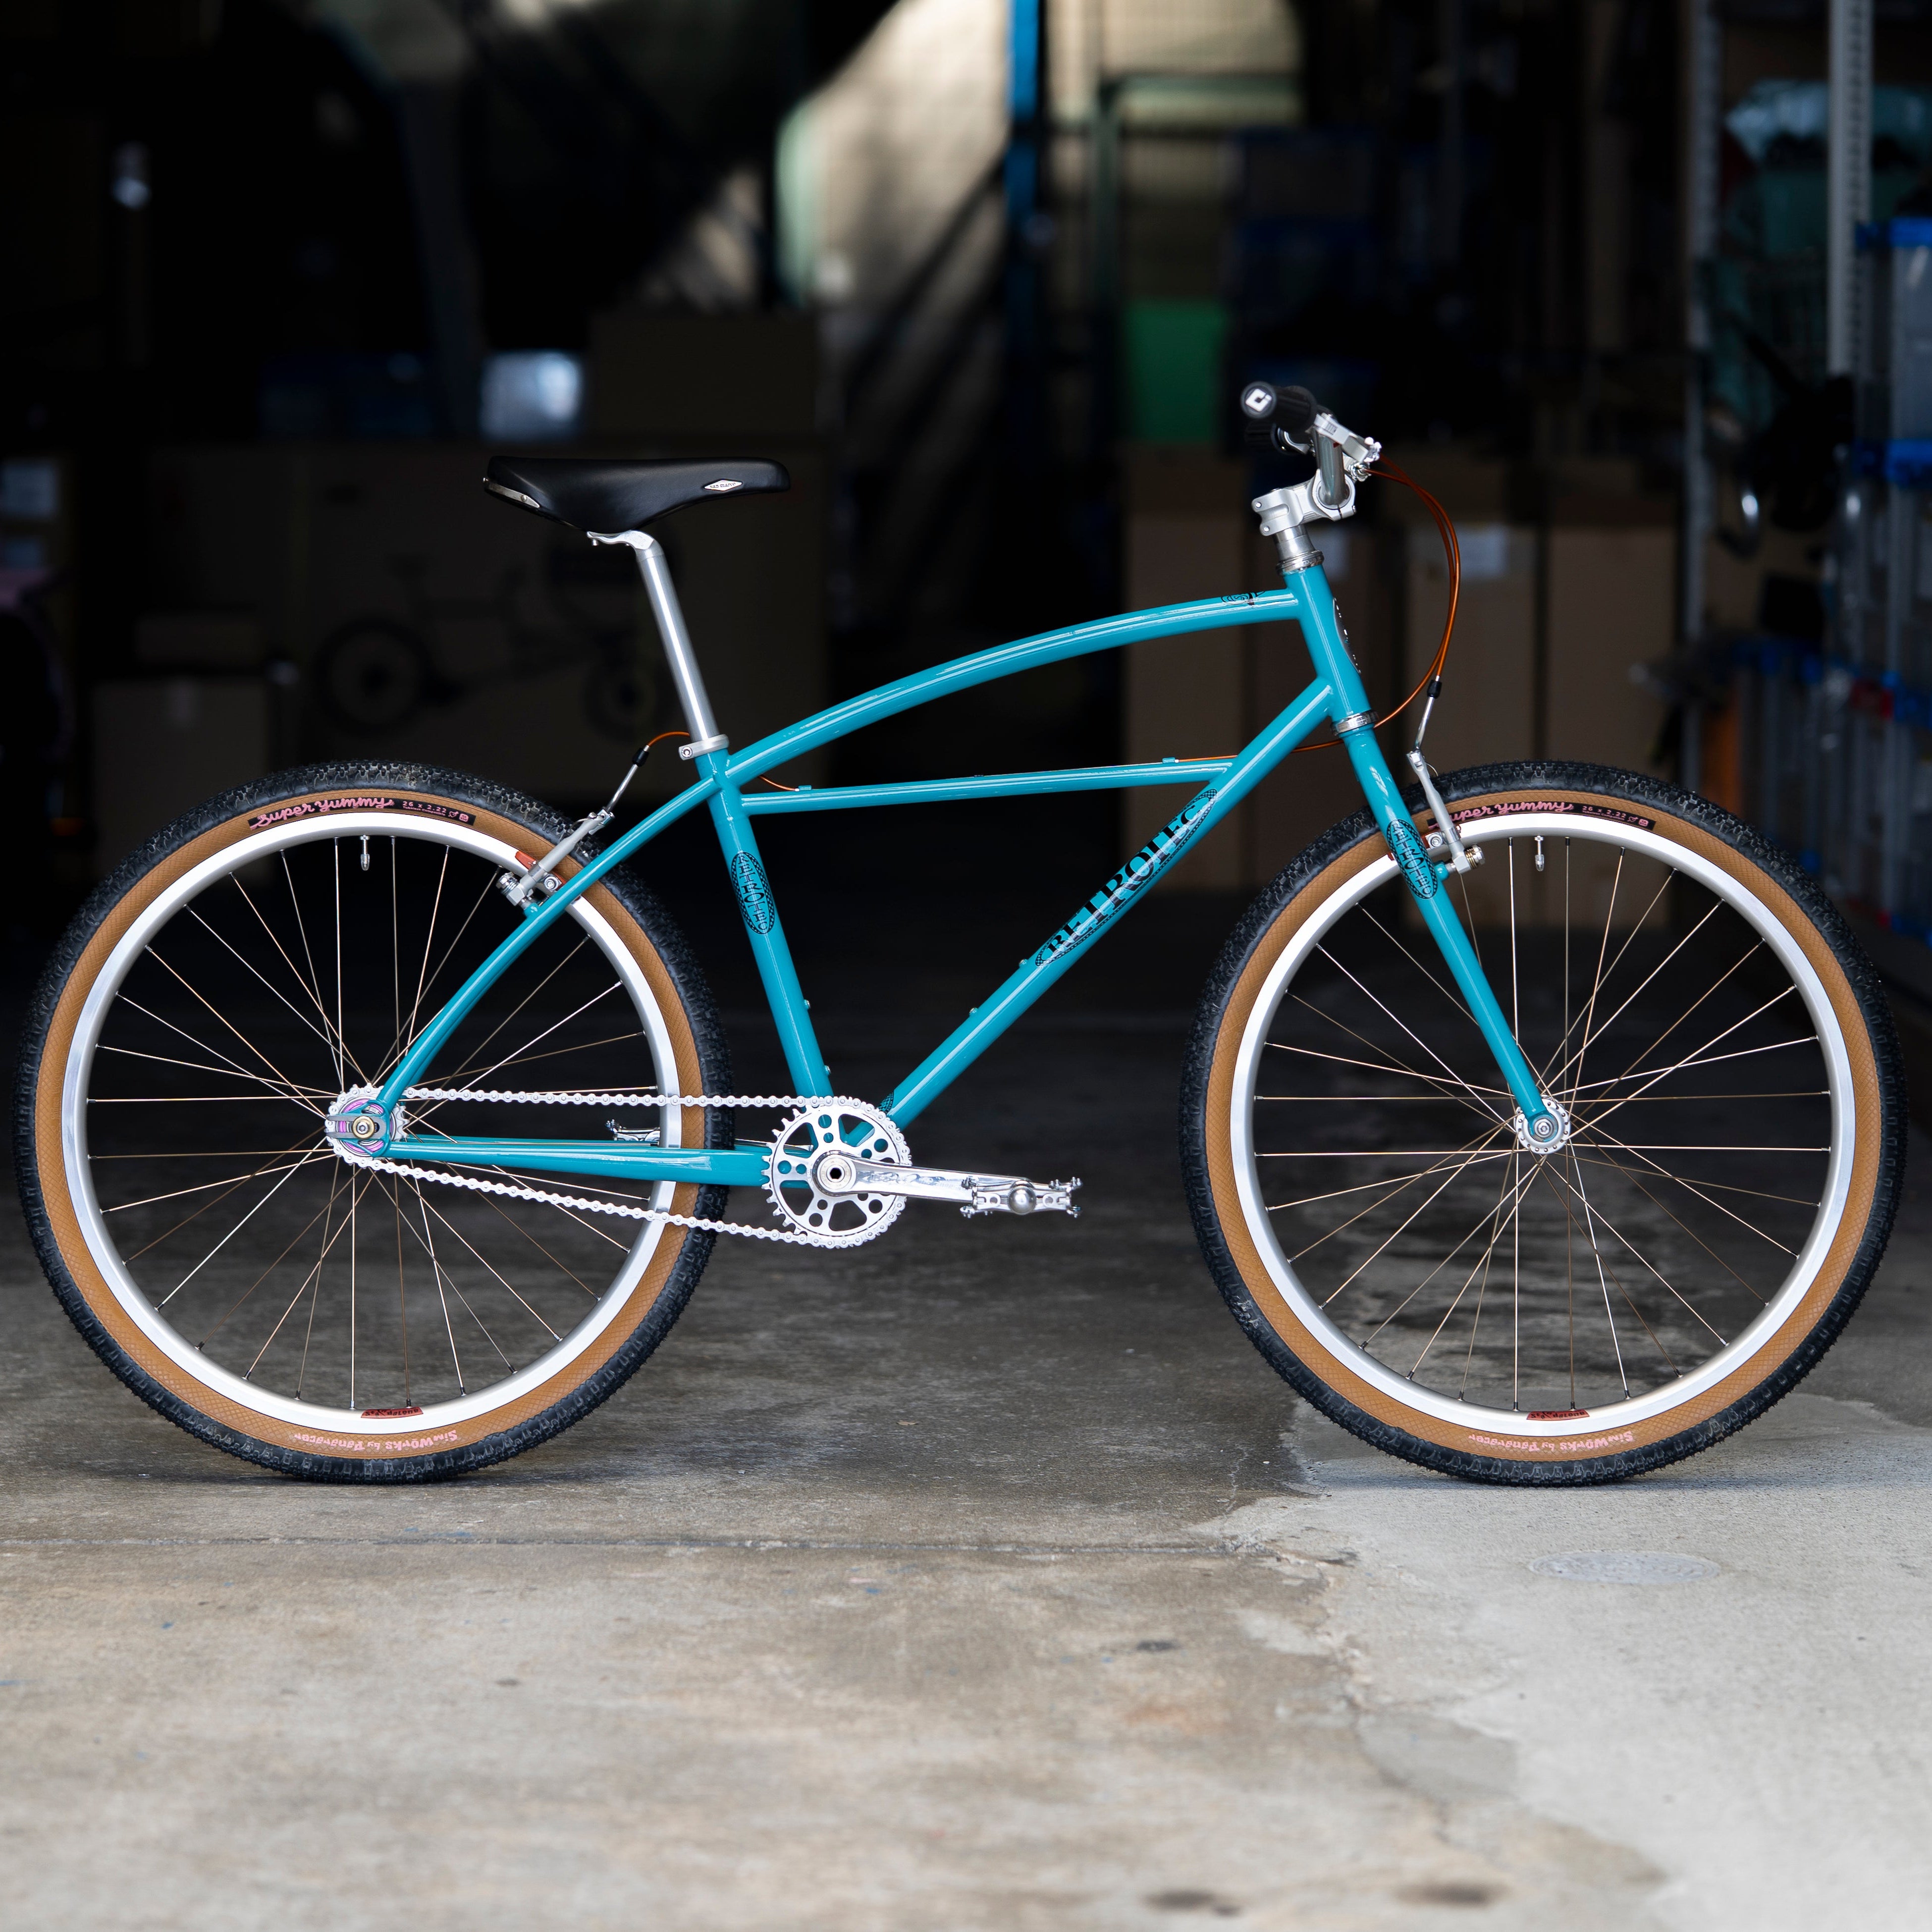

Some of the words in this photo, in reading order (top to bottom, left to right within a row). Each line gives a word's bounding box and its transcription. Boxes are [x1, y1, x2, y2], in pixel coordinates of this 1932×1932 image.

[250, 803, 315, 830] Super
[427, 805, 447, 813] 2.22
[1607, 809, 1626, 818] 2.22
[1392, 823, 1432, 895] RETROTEC
[1047, 805, 1203, 958] RETROTEC
[738, 855, 768, 931] RETROTEC
[294, 1432, 365, 1451] Panaracer
[367, 1441, 380, 1450] by
[1468, 1434, 1540, 1452] Panaracer
[1542, 1442, 1555, 1451] by
